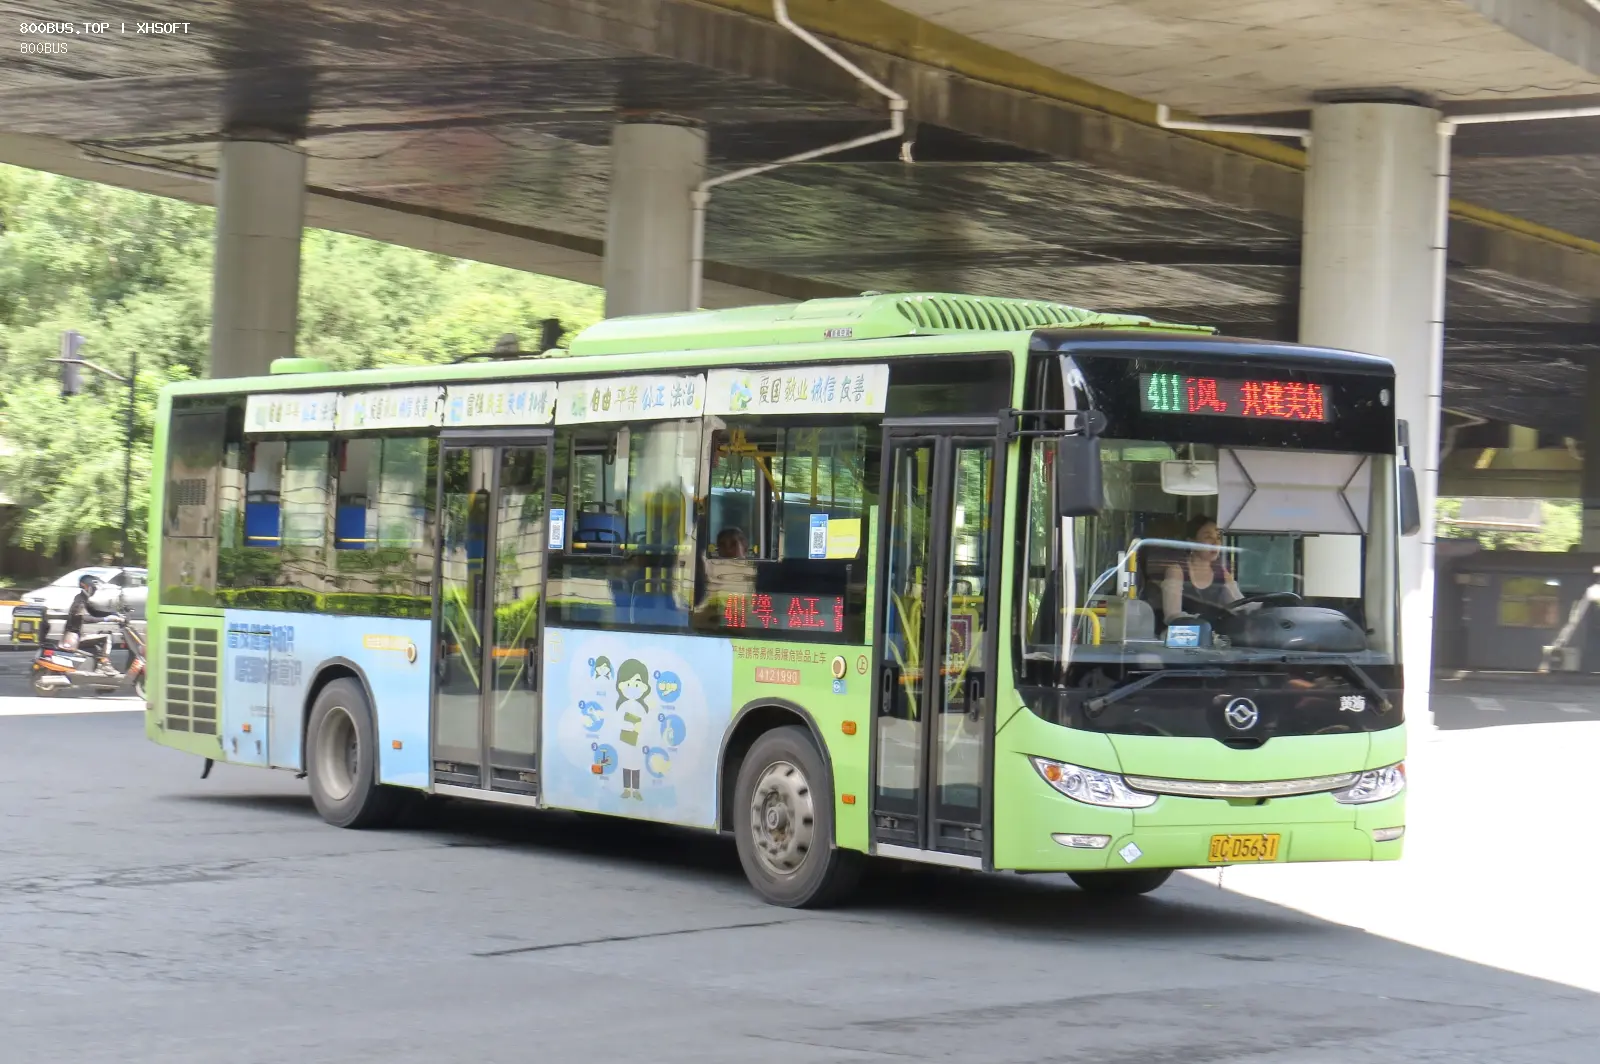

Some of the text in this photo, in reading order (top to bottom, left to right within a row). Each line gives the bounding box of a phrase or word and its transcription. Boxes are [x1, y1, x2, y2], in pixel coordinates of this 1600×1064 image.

[1147, 373, 1181, 411] 411
[724, 594, 746, 627] 411
[758, 669, 799, 685] 4121990
